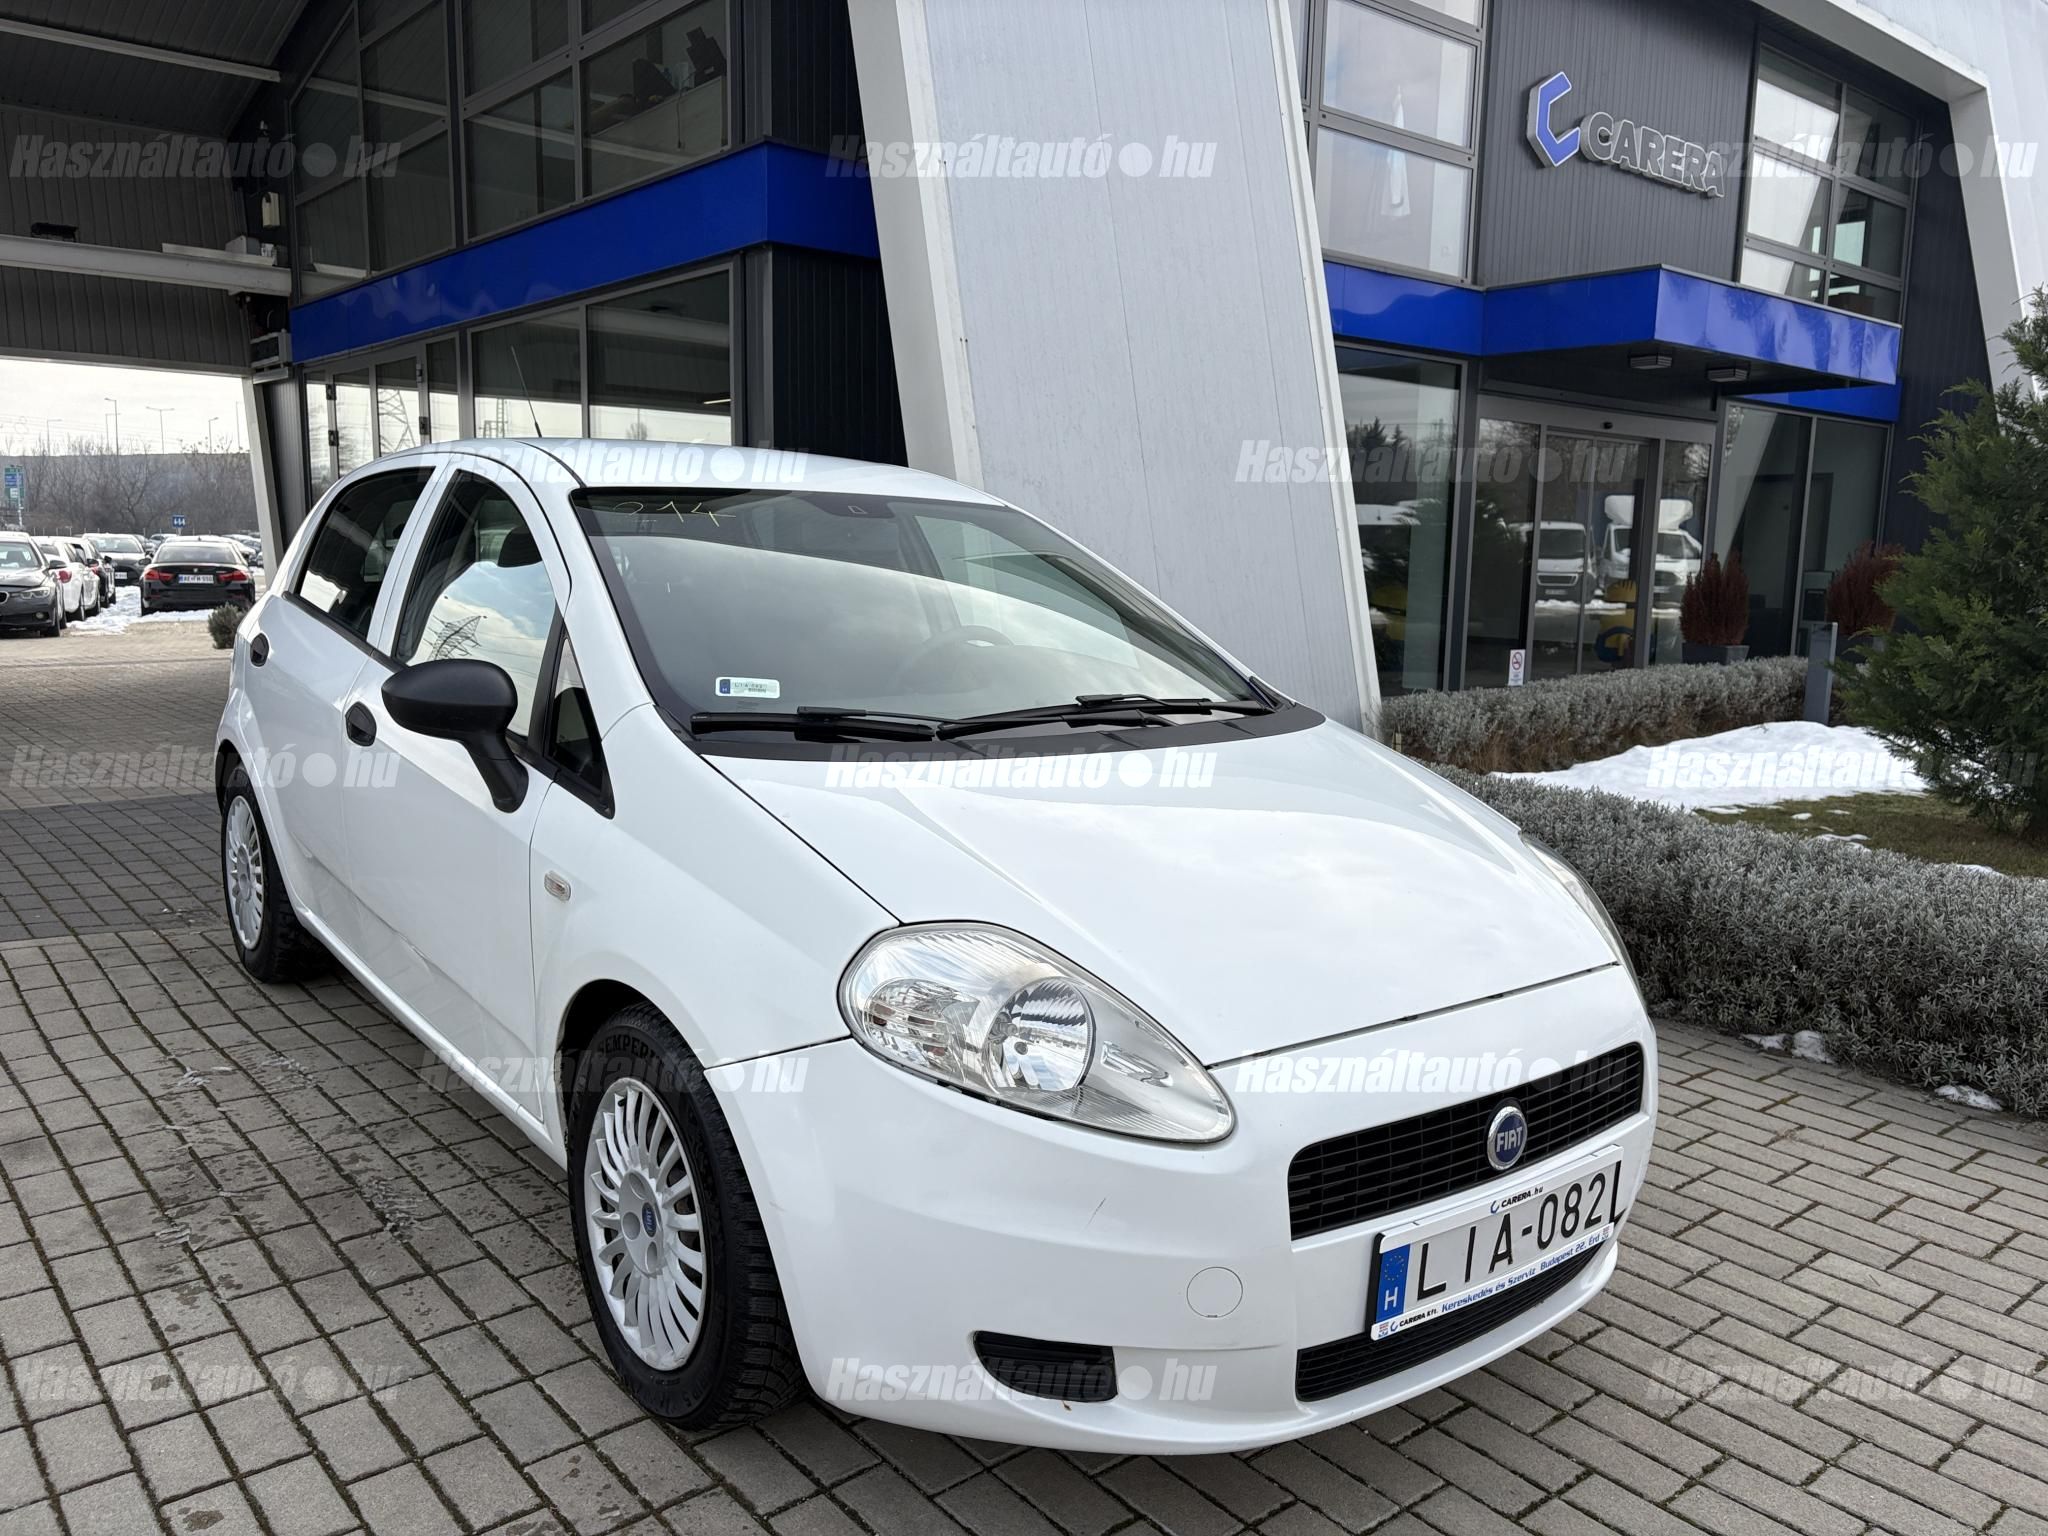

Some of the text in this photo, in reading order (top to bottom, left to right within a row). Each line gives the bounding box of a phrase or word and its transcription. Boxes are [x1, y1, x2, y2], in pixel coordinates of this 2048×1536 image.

[1587, 111, 1724, 198] CARERA
[1496, 1126, 1523, 1153] FIAT
[1417, 1173, 1606, 1301] LIA-082
[1384, 1286, 1399, 1311] H
[1399, 1312, 1426, 1327] CARERA
[1540, 1247, 1574, 1271] Budapest
